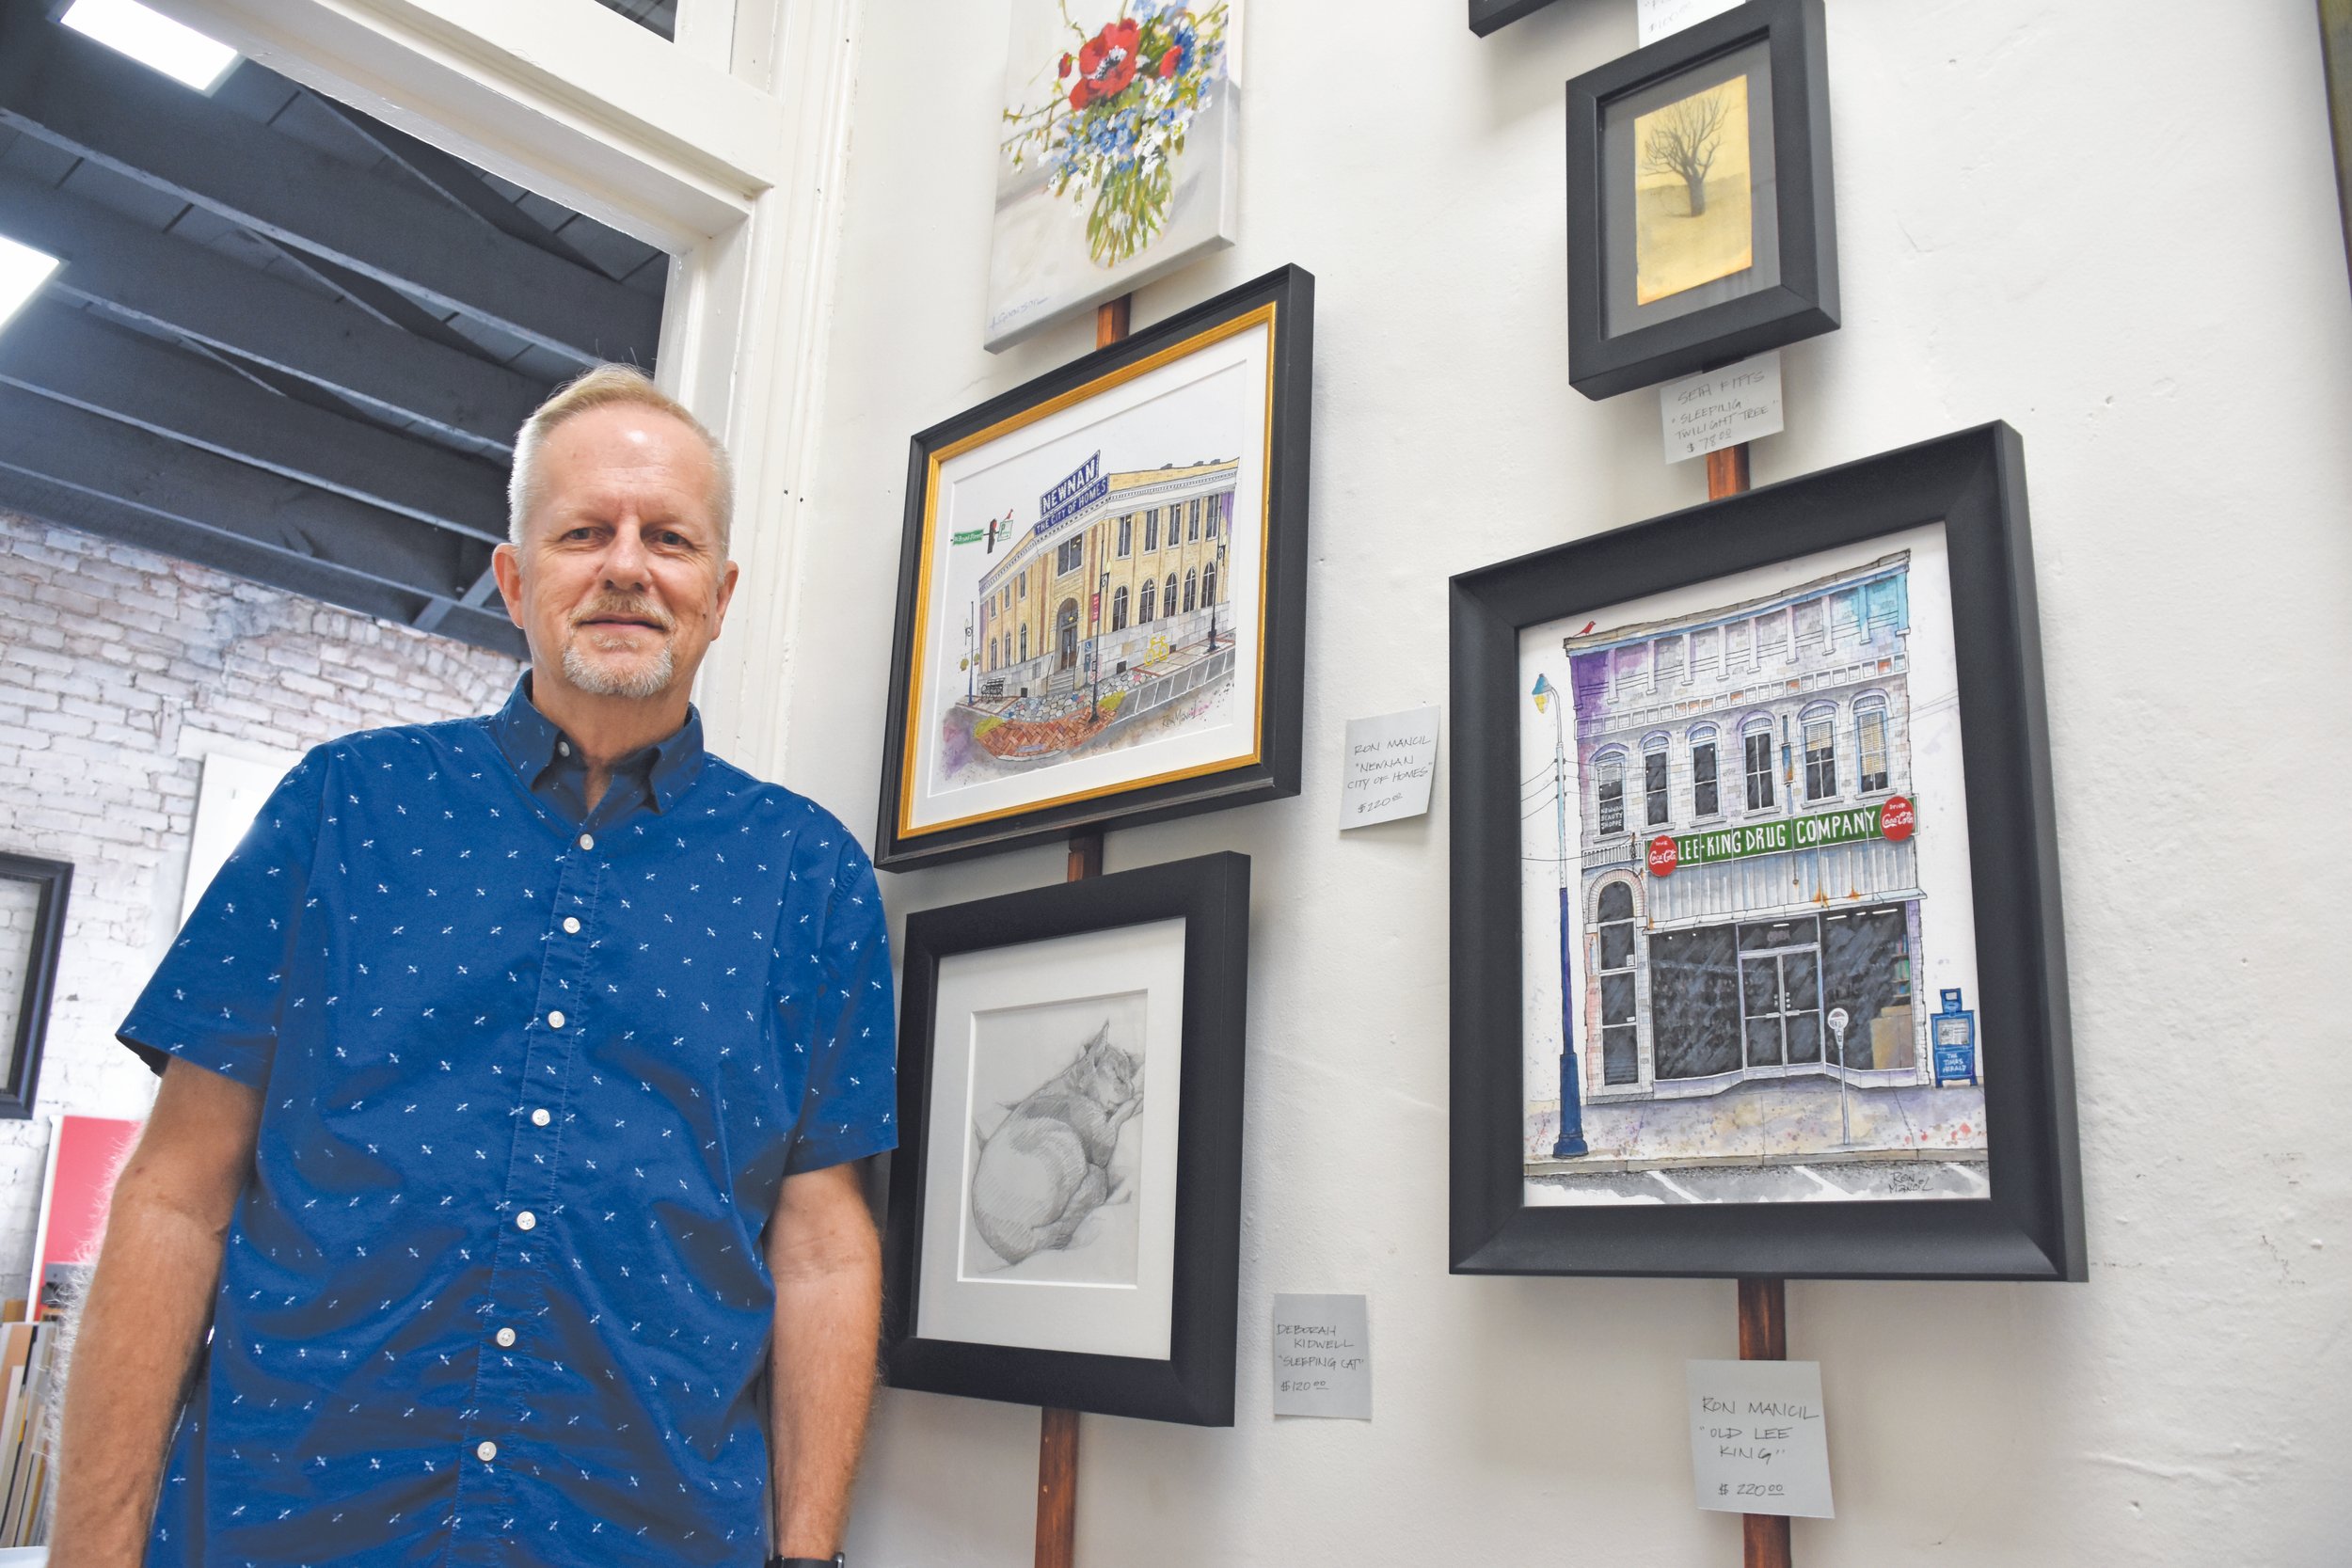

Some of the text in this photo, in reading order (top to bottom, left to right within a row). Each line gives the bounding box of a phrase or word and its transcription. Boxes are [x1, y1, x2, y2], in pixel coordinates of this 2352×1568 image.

[1676, 412, 1738, 439] TWILIGHT
[1042, 458, 1095, 514] NEWNAN
[1036, 479, 1107, 534] THE CITY OF HOMES
[1354, 736, 1431, 755] RON MANCIL
[1347, 778, 1371, 790] CITY
[1374, 775, 1390, 784] OF
[1677, 810, 1876, 862] LEE-KING DRUG COMPANY
[1277, 1323, 1337, 1336] DEBORAH
[1294, 1338, 1355, 1349] KIDWELL
[1702, 1396, 1820, 1419] RON MANCIL
[1755, 1426, 1794, 1440] LEE
